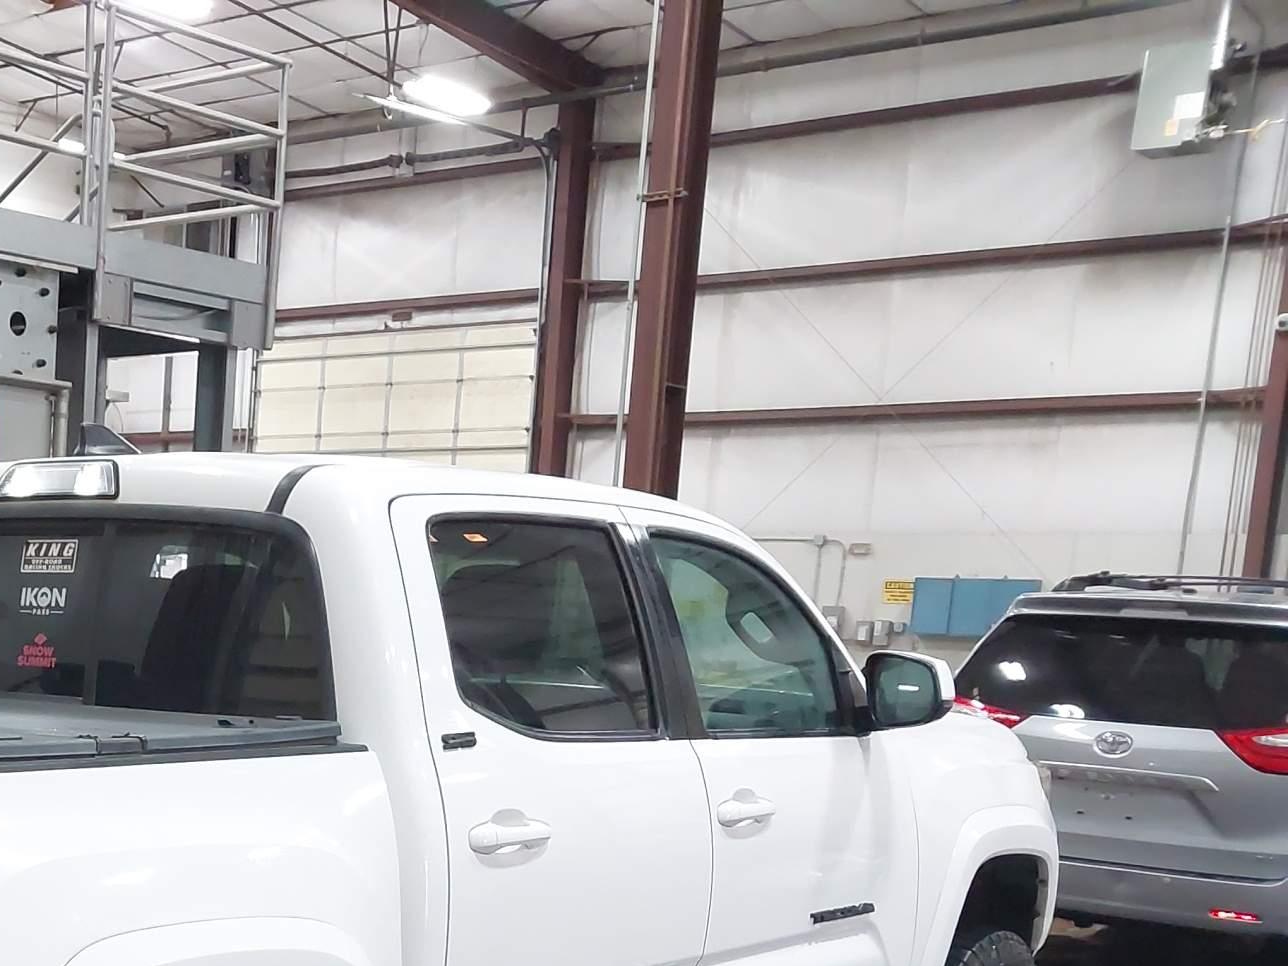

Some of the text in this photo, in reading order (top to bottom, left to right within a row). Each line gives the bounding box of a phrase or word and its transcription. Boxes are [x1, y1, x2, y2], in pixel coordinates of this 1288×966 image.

[25, 542, 76, 557] KING
[20, 587, 67, 608] IKON
[23, 644, 55, 657] SNOW
[17, 655, 57, 668] SUMMIT
